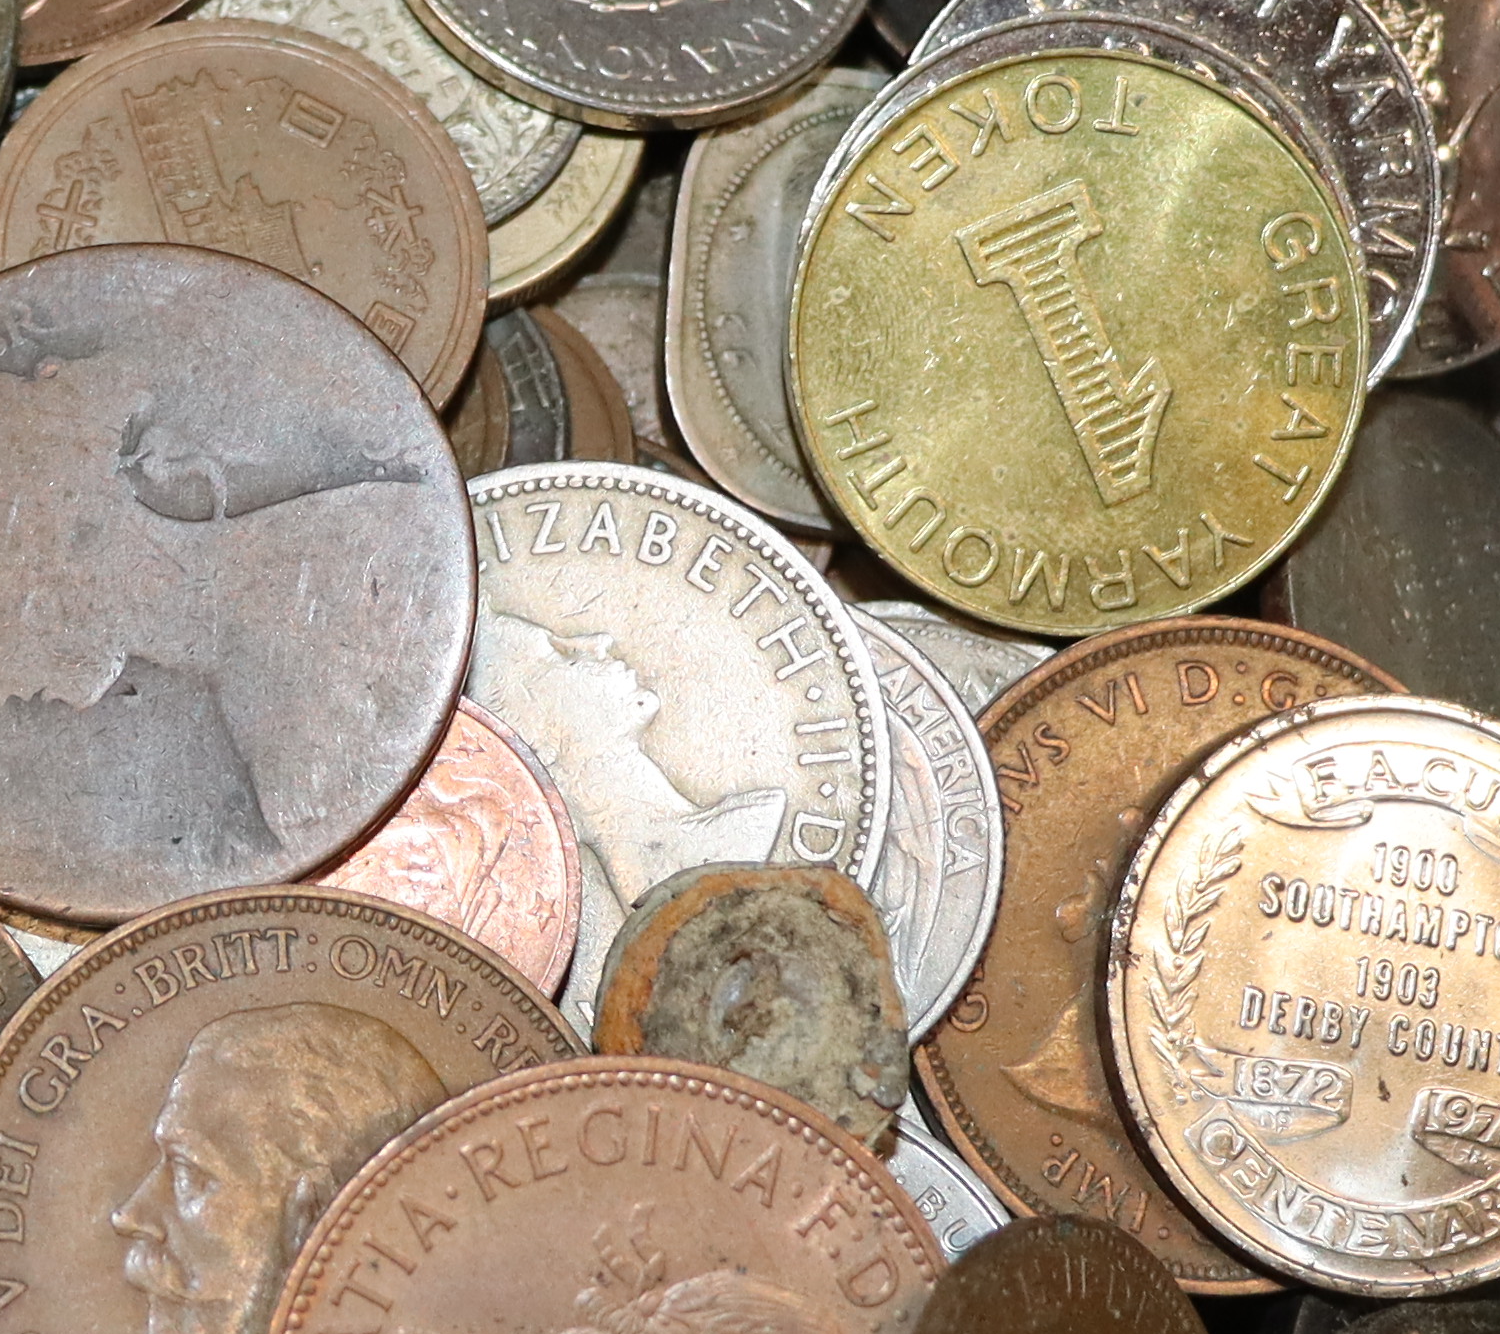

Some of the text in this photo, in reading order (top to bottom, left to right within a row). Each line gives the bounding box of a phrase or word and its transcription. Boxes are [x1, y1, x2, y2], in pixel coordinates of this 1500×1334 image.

[845, 72, 1140, 243] TOKEN
[824, 210, 1344, 614] GREAT YARMOUTH
[482, 500, 827, 681] IZABETH
[877, 664, 989, 879] AMERICA
[1371, 840, 1461, 898] 1900
[1239, 984, 1370, 1050] DERBY
[1355, 954, 1443, 1009] 1903
[1232, 1056, 1346, 1113] 1872
[459, 1104, 787, 1210] REGINA
